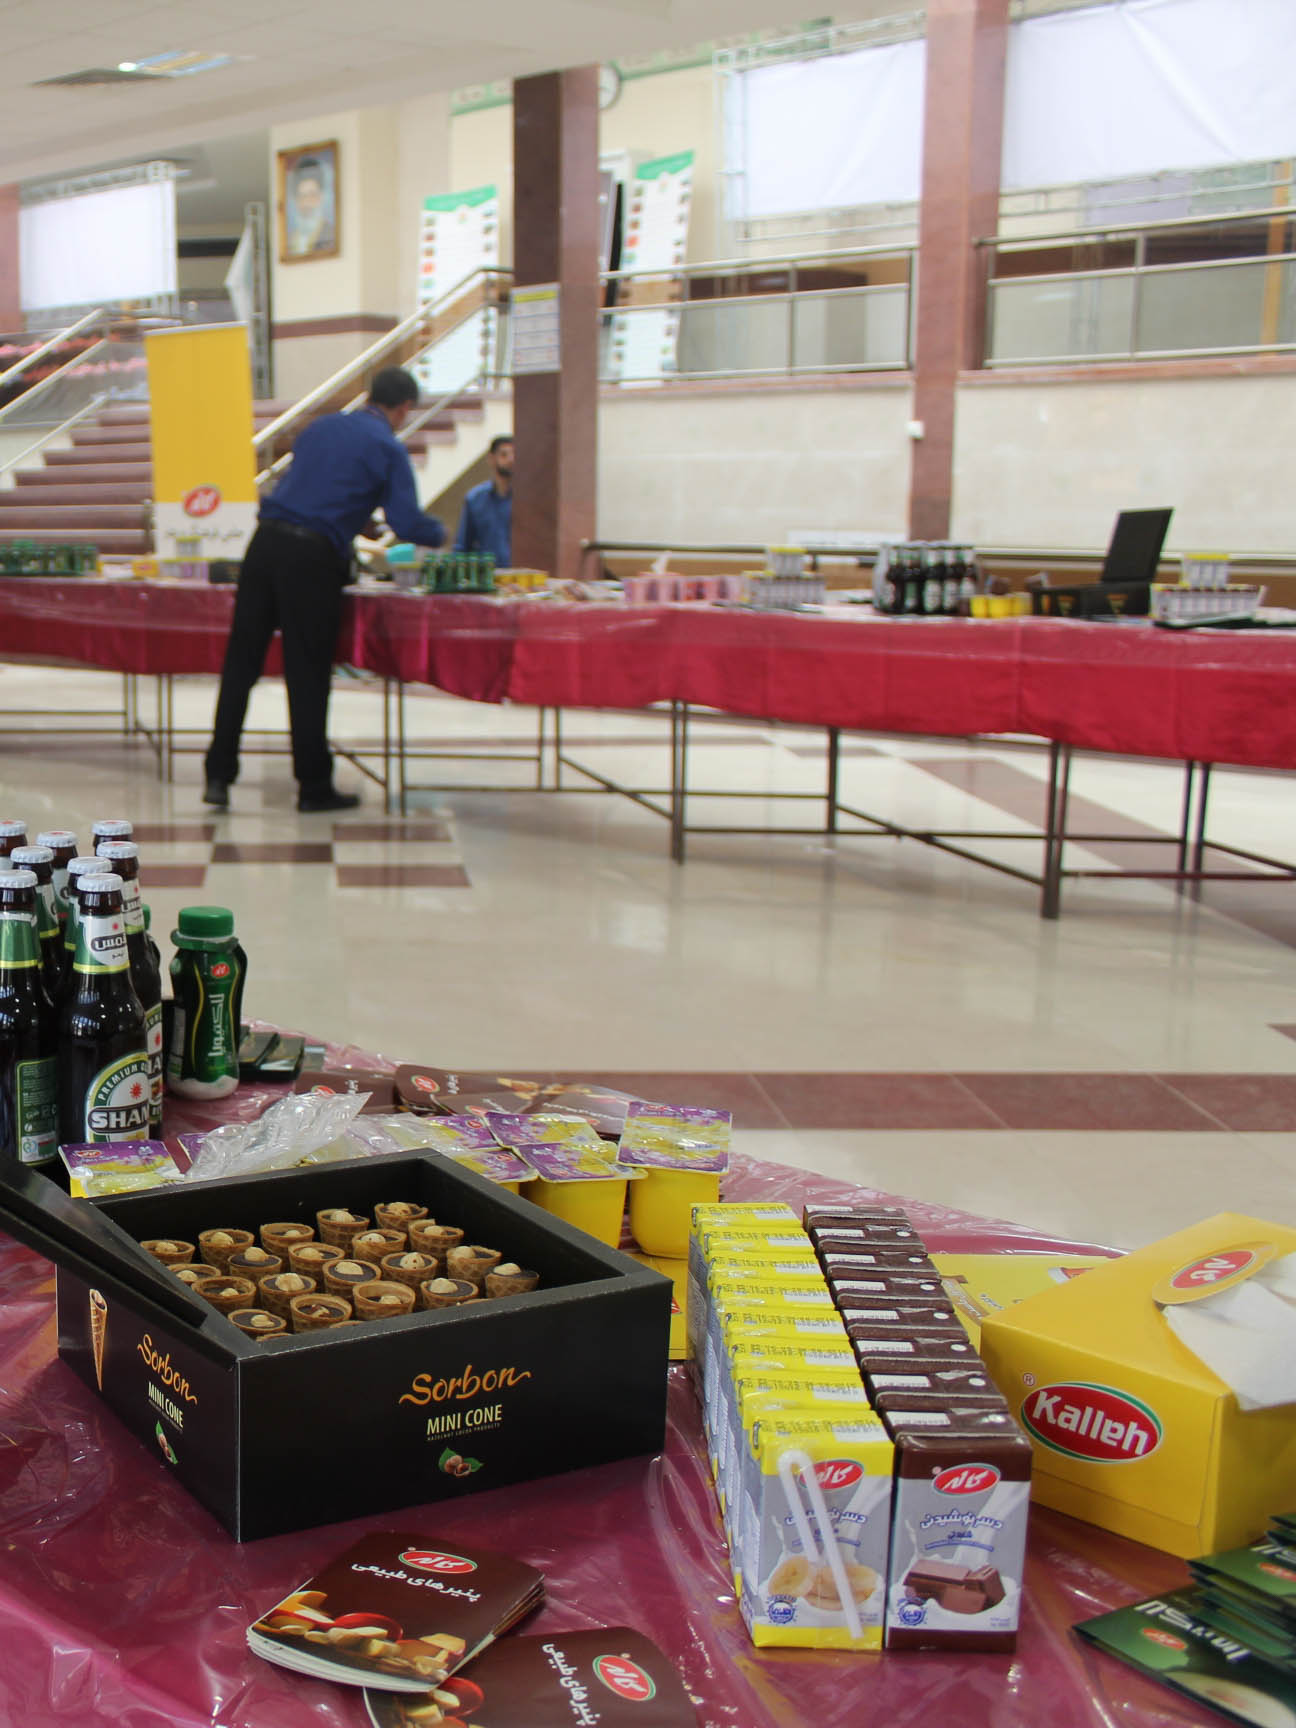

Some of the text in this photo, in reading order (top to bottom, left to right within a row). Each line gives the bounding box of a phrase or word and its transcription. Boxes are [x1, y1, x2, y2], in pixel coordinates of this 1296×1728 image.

[97, 1063, 139, 1101] PREMIUM
[136, 1333, 199, 1406] Sorbon
[398, 1364, 532, 1406] Sorbon
[148, 1381, 164, 1410] MINI
[165, 1398, 184, 1428] CONE
[426, 1404, 503, 1436] MINI CONE
[1032, 1390, 1149, 1456] Kalleh
[942, 1471, 988, 1492] کاله
[920, 1508, 1003, 1529] دسر نوشیدنی
[352, 1563, 408, 1581] طبیعی
[408, 1553, 464, 1570] کاله
[542, 1642, 578, 1679] طبیعی
[603, 1661, 647, 1693] کاله
